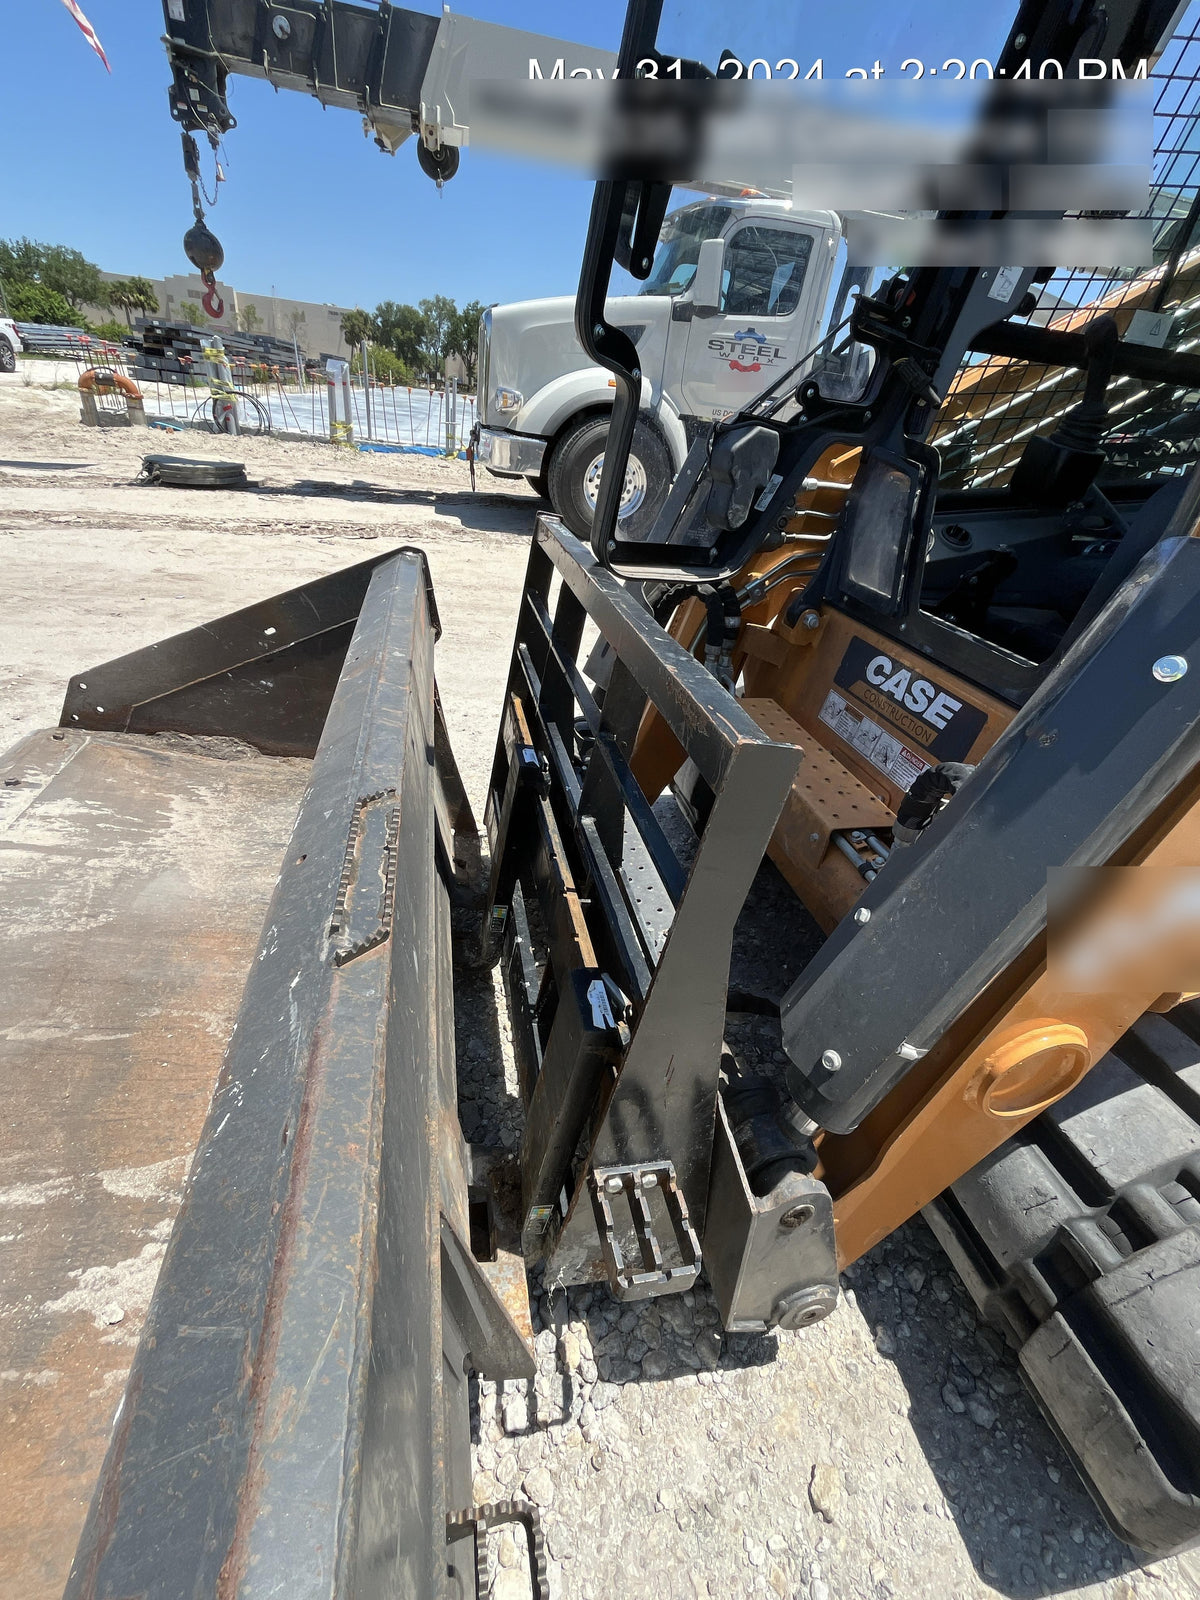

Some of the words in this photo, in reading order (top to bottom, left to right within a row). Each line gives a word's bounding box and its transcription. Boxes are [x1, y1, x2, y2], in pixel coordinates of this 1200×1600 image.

[708, 339, 787, 359] STEEL
[719, 351, 774, 363] WORX
[712, 408, 722, 416] US
[866, 655, 963, 730] CASE
[864, 689, 932, 742] CONSTRUCTION
